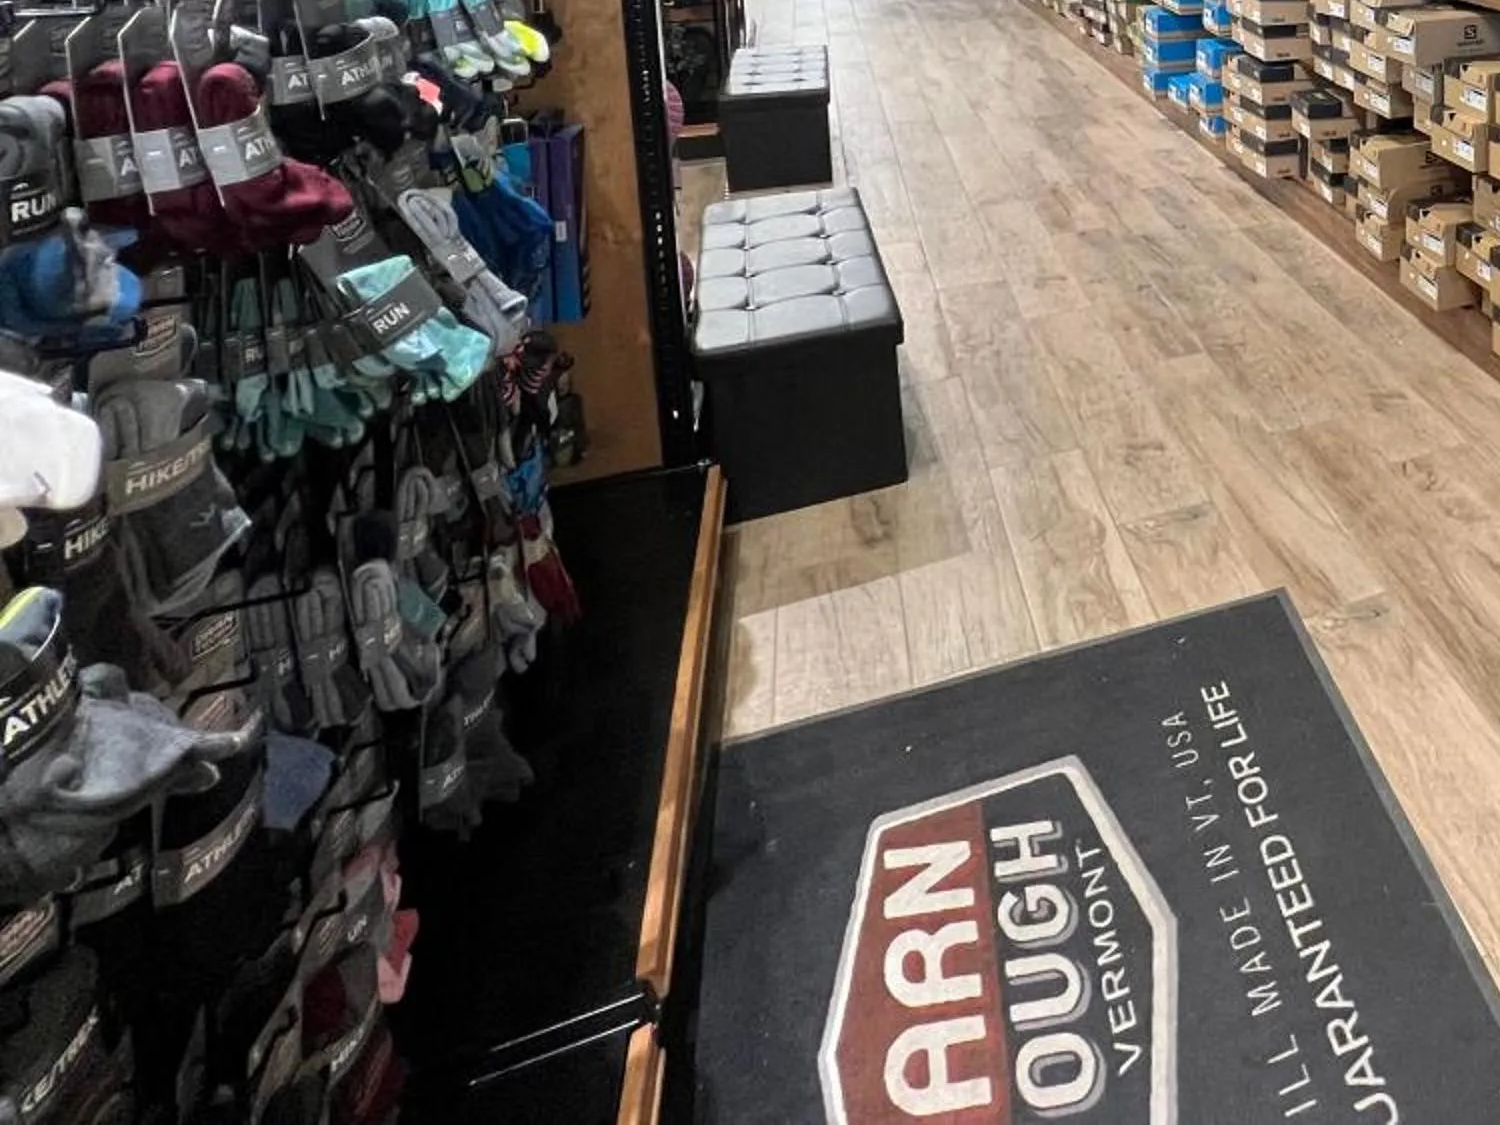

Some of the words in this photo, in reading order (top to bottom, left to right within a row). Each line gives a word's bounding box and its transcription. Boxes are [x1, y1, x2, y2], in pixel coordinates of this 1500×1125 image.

[372, 302, 411, 335] RUN
[1161, 711, 1199, 769] USA
[1200, 680, 1249, 750] LIFE
[1228, 750, 1280, 829] FOR
[1203, 843, 1241, 884] IN
[883, 840, 993, 1117] ARN
[989, 820, 1104, 1116] OUGH
[1075, 837, 1143, 1076] VERMONT
[1220, 896, 1283, 1017] MADE
